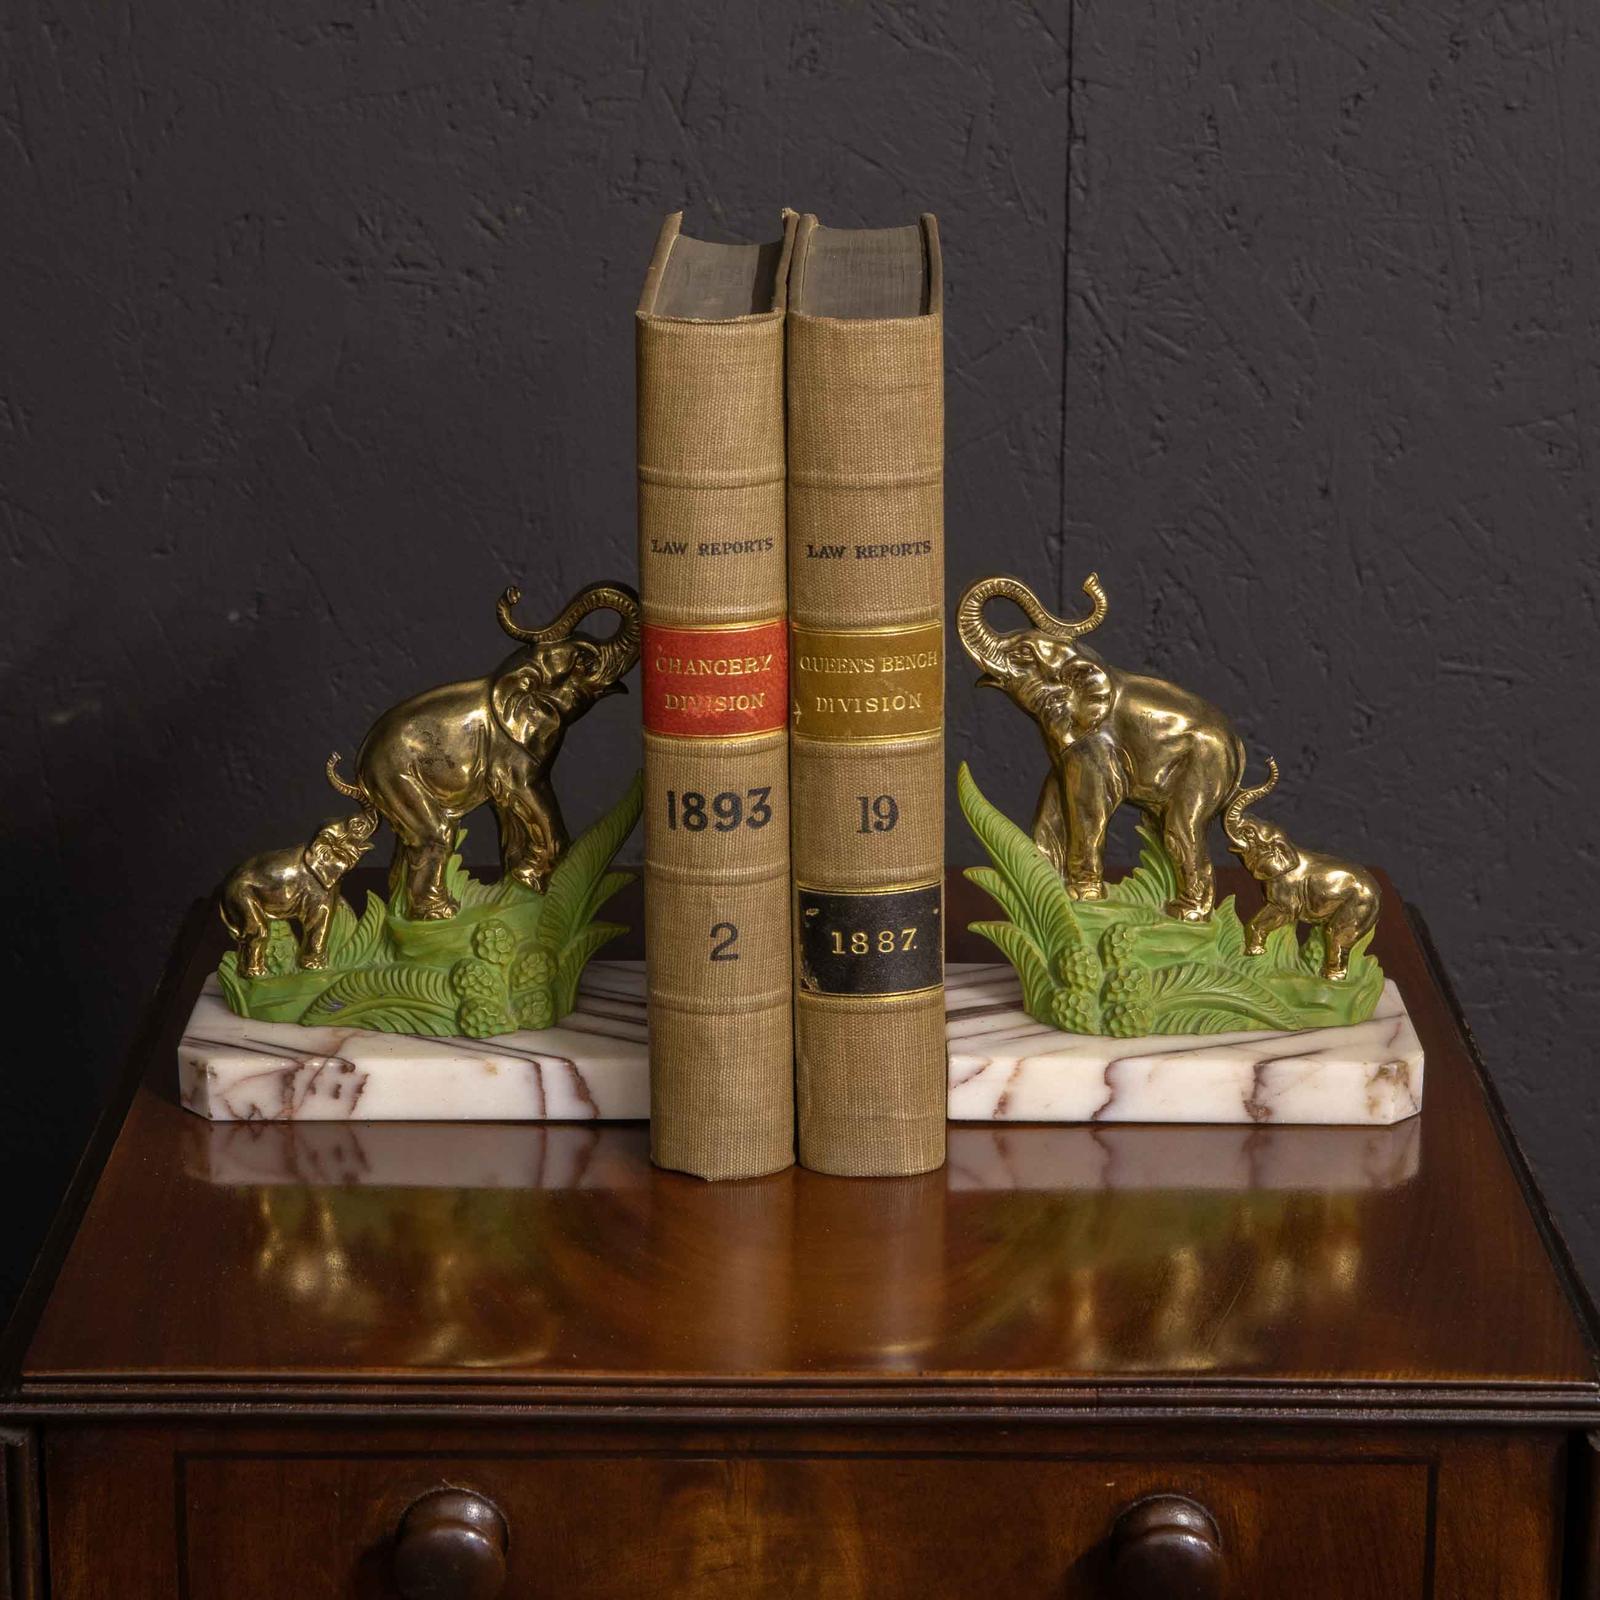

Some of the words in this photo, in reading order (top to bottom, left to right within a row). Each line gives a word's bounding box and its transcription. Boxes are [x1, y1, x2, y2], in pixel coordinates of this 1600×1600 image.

[651, 539, 688, 555] LAW
[697, 537, 774, 556] REPORTS
[806, 544, 847, 559] LAW
[855, 541, 932, 559] REPORTS
[655, 654, 773, 675] CHANCERY
[800, 656, 875, 673] QUEEN'S
[881, 652, 938, 673] BENCH
[816, 693, 922, 712] DIVISION
[667, 786, 772, 832] 1893
[856, 795, 899, 833] 19
[710, 922, 739, 961] 2
